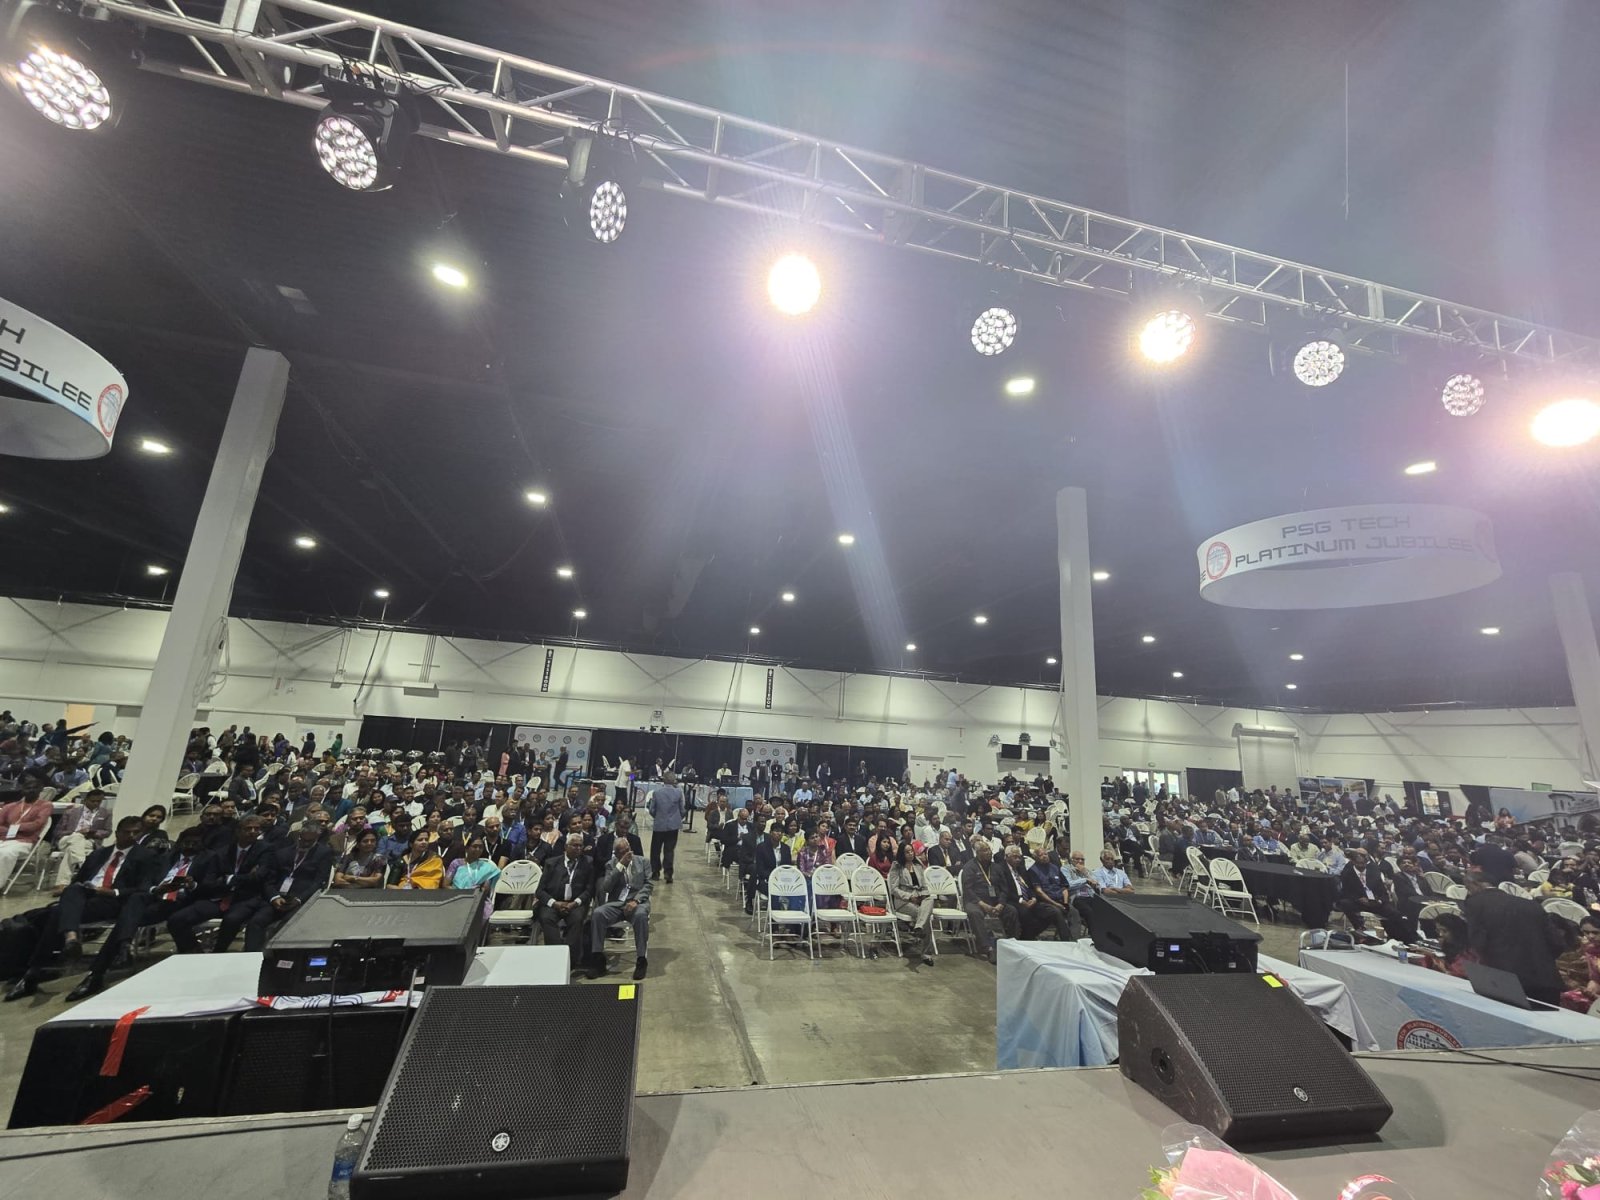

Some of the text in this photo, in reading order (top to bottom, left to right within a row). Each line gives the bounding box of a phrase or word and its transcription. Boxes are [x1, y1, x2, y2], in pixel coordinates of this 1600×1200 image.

[1281, 514, 1410, 539] PSG TECH
[1235, 538, 1356, 568] PLATINUM
[1365, 535, 1473, 552] JUBILEE
